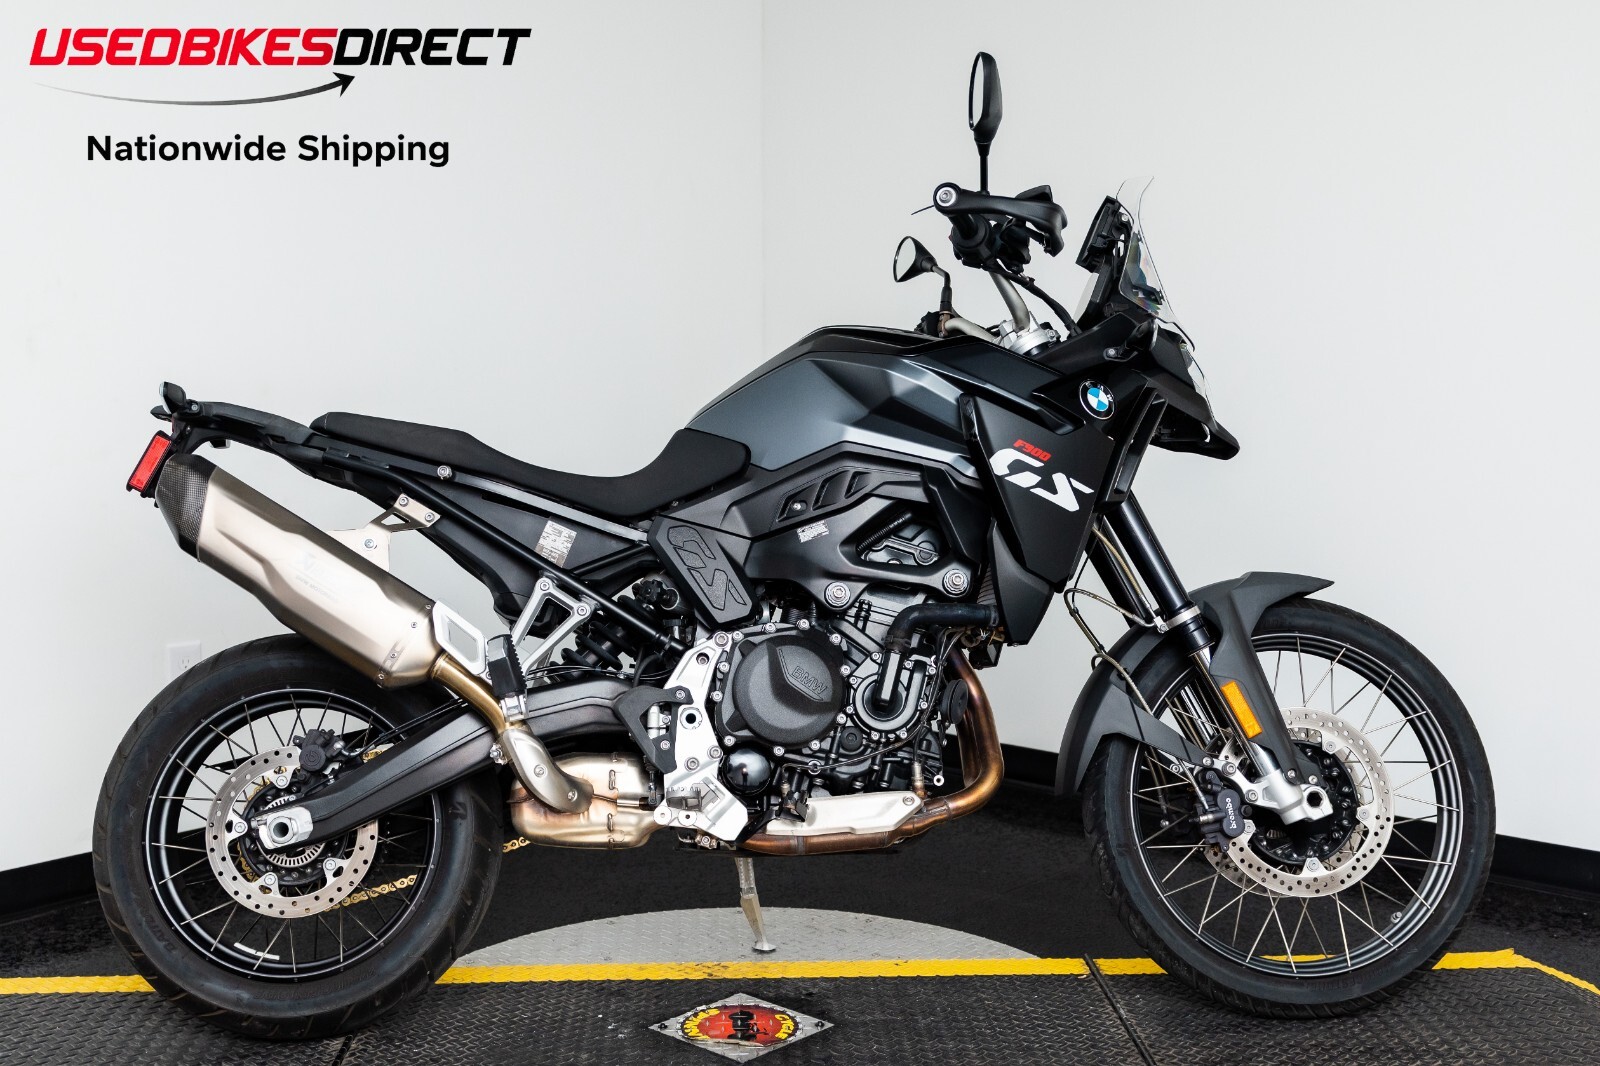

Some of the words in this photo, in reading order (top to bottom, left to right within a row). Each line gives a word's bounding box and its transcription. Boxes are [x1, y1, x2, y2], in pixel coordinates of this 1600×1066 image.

[1013, 439, 1052, 461] F900
[989, 447, 1095, 512] GS
[791, 665, 829, 695] BMW
[1225, 797, 1237, 829] brembo
